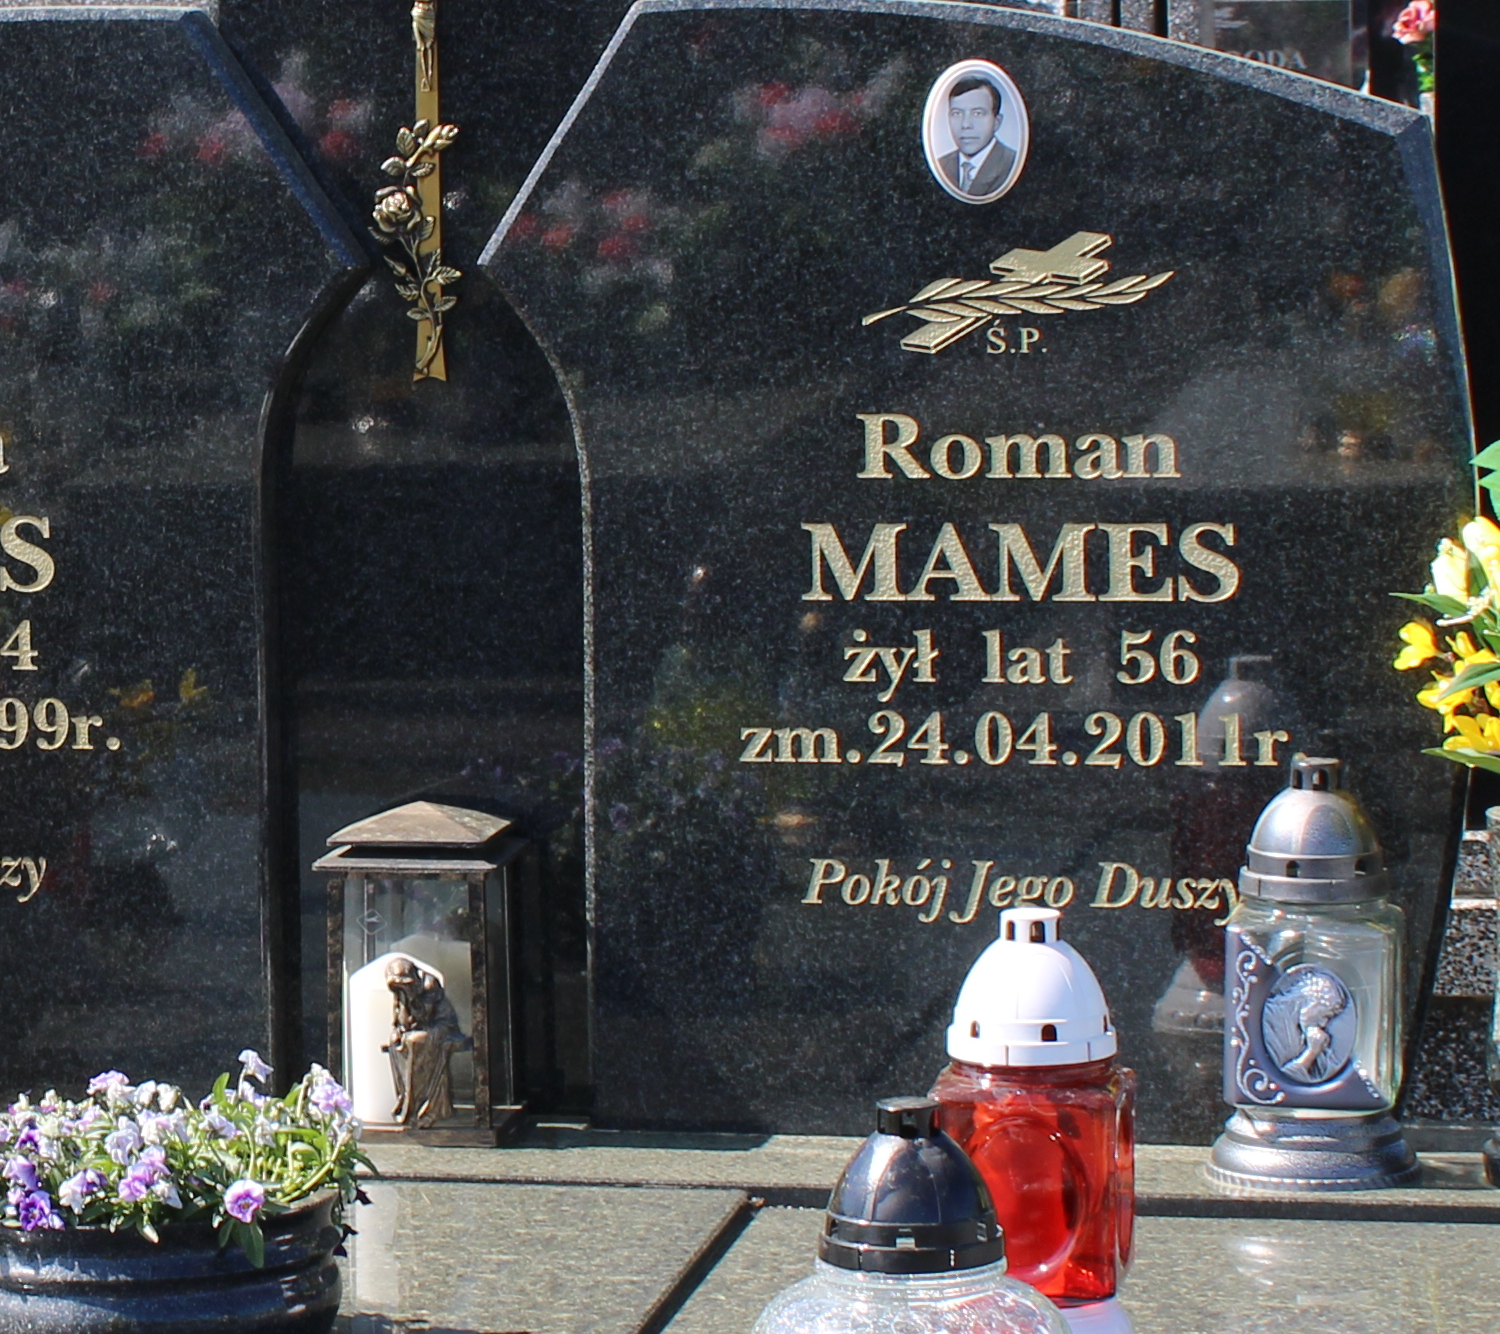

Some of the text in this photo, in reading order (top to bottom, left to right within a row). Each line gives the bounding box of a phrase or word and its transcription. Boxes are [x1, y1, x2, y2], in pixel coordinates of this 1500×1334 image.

[985, 319, 1049, 355] Ś.P.
[855, 412, 1182, 480] Roman
[800, 521, 1242, 603] MAMES
[842, 628, 1201, 703] żył lat 56
[800, 857, 1245, 927] Pokój Jego Duszy
